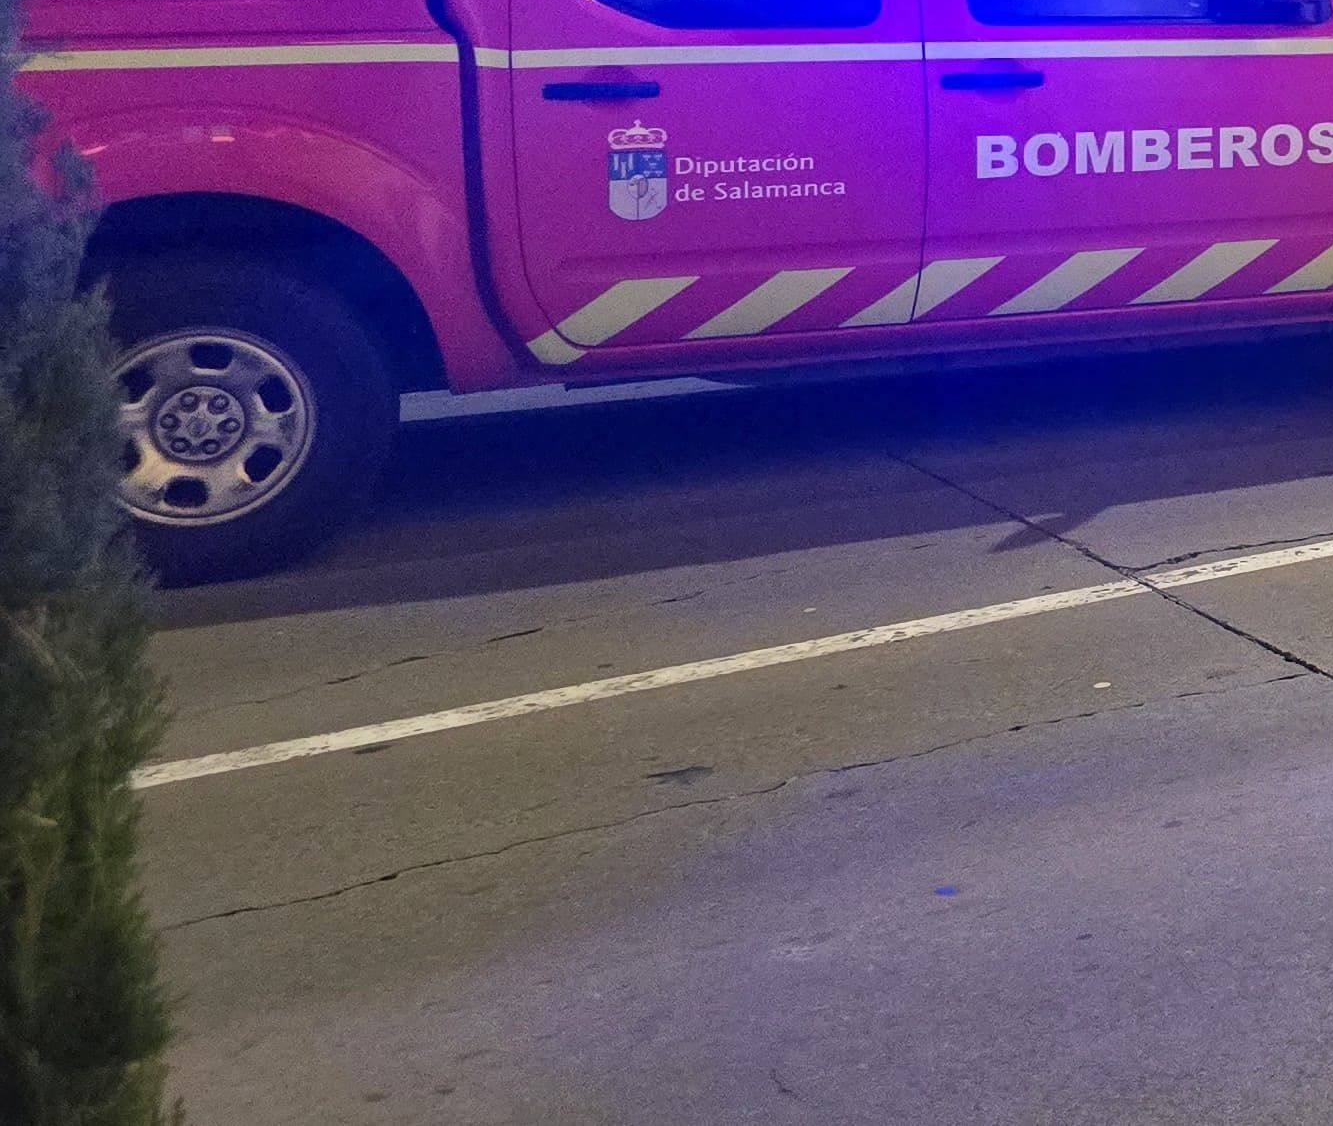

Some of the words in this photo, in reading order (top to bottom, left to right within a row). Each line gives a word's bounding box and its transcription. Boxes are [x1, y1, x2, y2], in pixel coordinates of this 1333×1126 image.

[675, 153, 815, 177] Diputación
[675, 184, 705, 202] de
[714, 181, 846, 201] Salamanca
